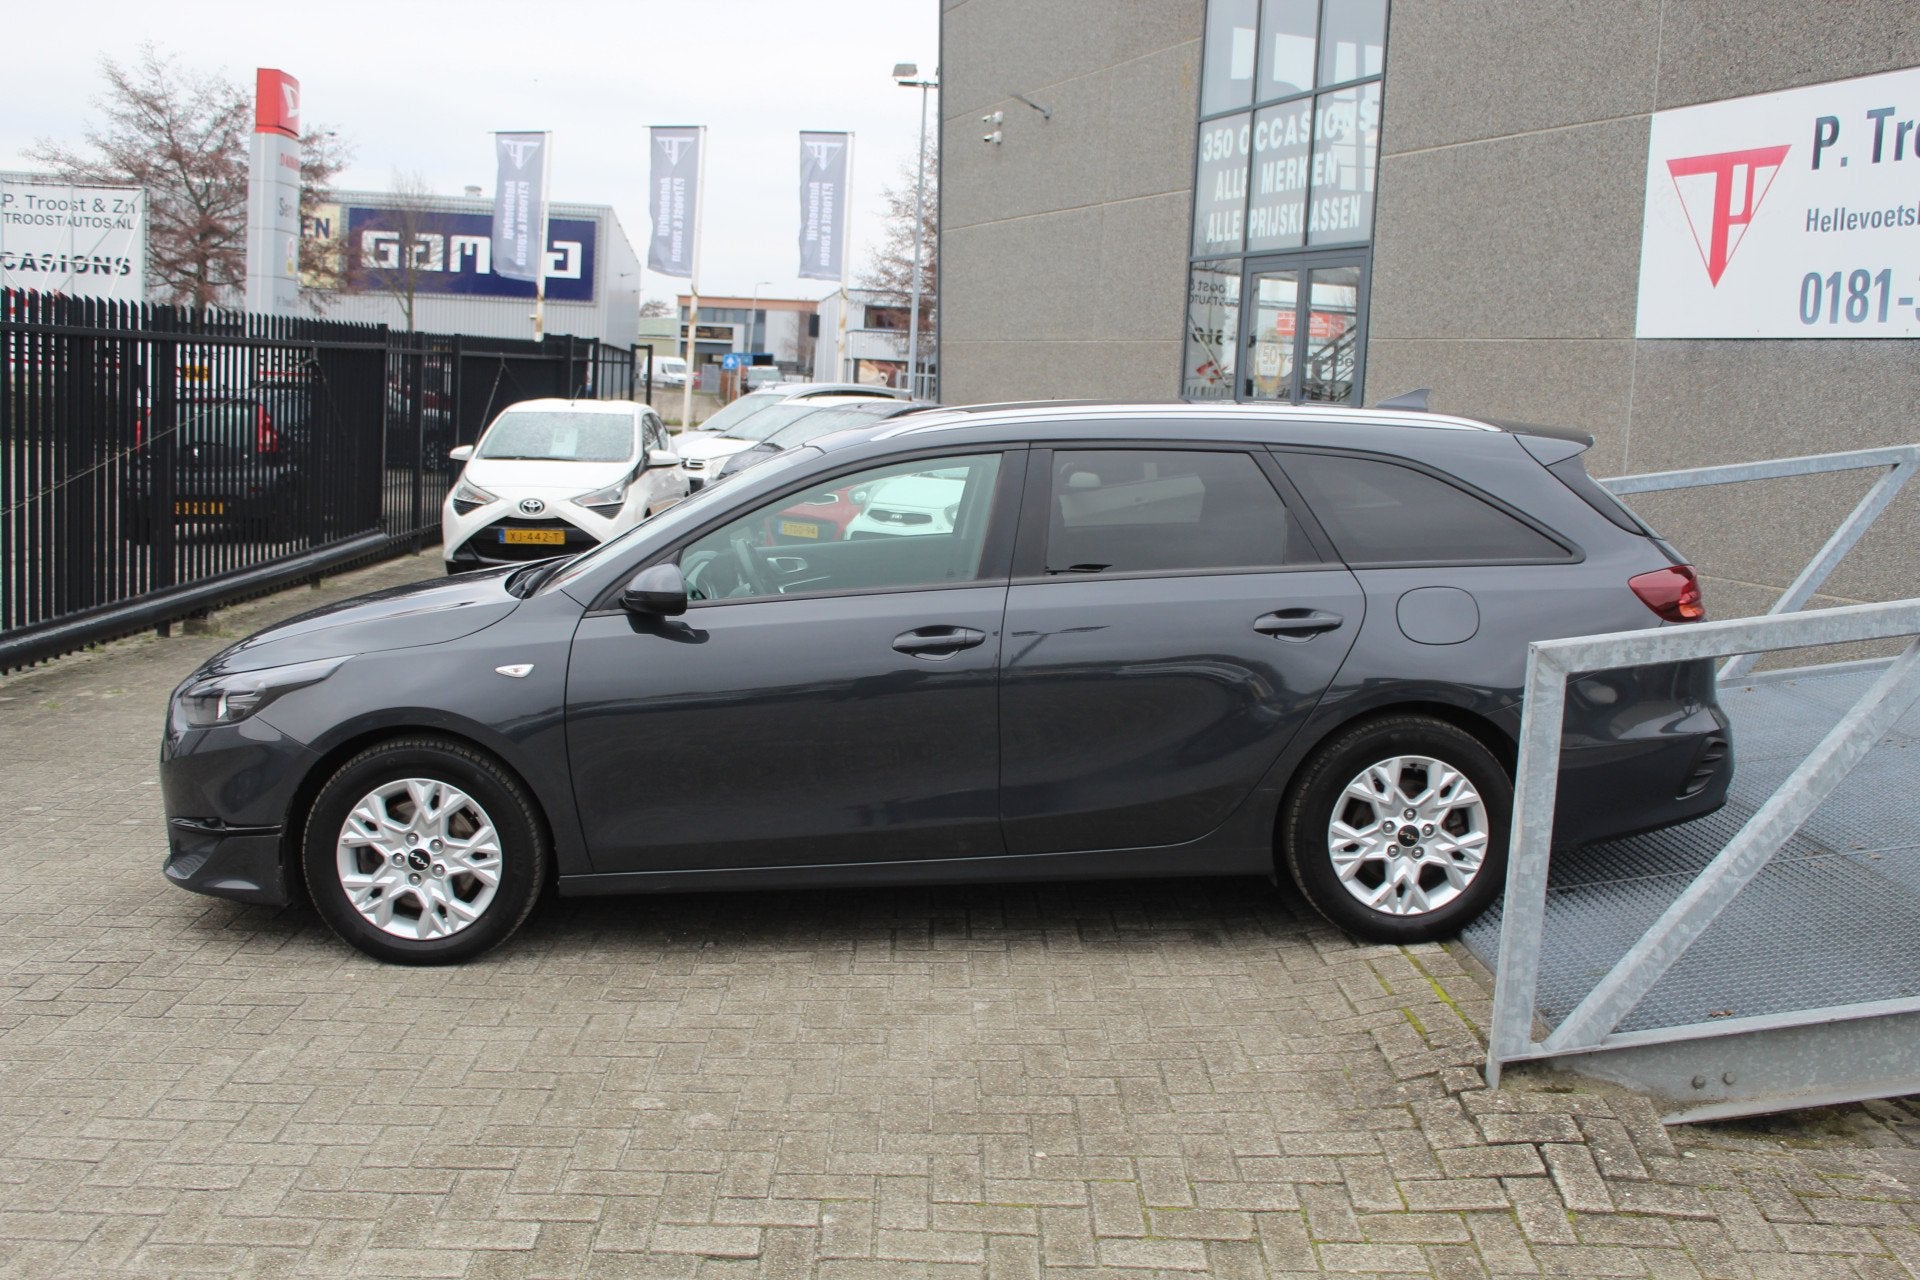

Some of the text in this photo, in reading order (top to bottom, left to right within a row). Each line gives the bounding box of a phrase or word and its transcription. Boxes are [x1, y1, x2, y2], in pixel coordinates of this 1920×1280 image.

[1203, 128, 1233, 162] 350
[1811, 106, 1920, 170] P. Tr
[1260, 151, 1338, 195] MERKEN
[3, 212, 135, 230] TROOSTAUTOS.NL
[25, 195, 86, 212] Troost
[93, 199, 106, 213] &
[1206, 209, 1240, 243] ALLE
[509, 531, 560, 543] XJ-442-T
